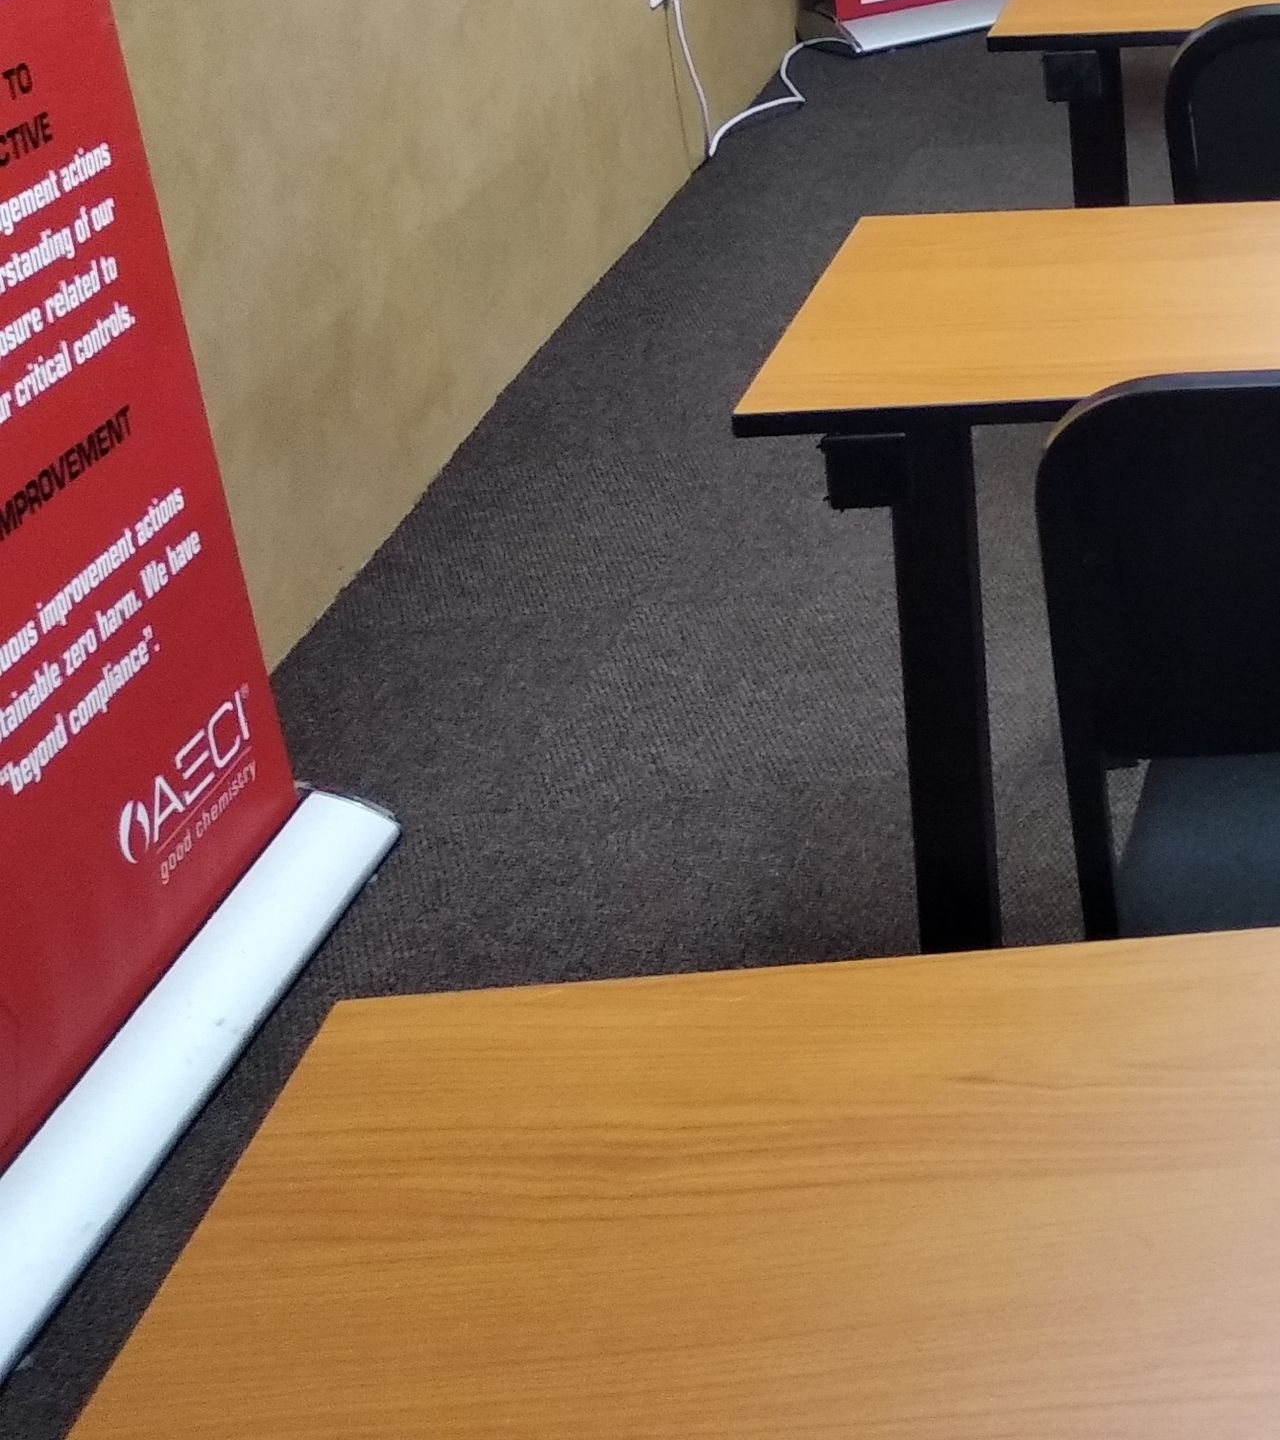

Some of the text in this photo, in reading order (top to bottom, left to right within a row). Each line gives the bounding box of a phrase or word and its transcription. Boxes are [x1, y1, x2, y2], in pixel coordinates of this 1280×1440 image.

[3, 63, 33, 100] TO
[60, 142, 112, 192] actions
[74, 205, 91, 244] of
[91, 197, 115, 232] our
[45, 259, 101, 323] related
[101, 256, 118, 284] to
[15, 340, 72, 407] critical
[74, 301, 136, 364] controls.
[0, 487, 184, 676] uous improvement actions
[0, 530, 202, 743] tainable zero harm. We have
[160, 759, 257, 885] good chemistry
